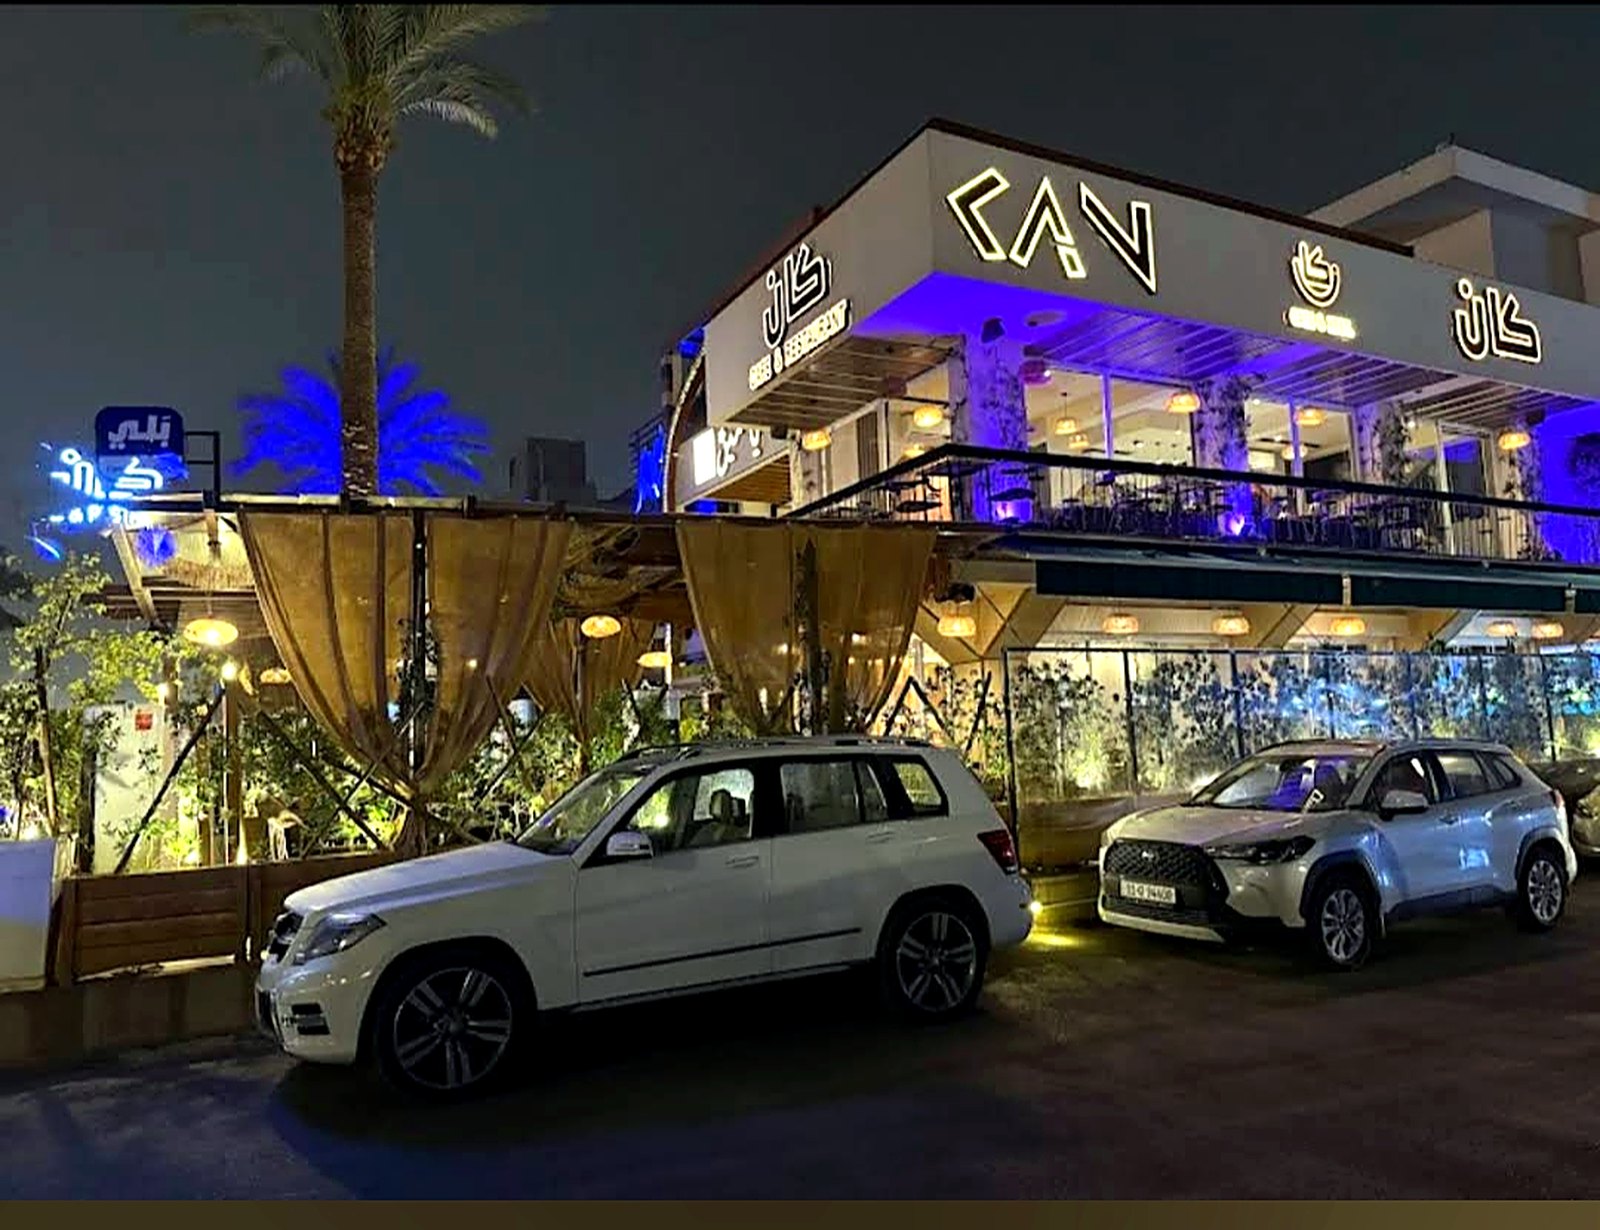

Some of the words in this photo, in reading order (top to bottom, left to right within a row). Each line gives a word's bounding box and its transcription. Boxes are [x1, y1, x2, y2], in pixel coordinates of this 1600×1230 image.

[946, 167, 1156, 293] CAN
[763, 243, 828, 349] كان
[1455, 278, 1541, 363] كان
